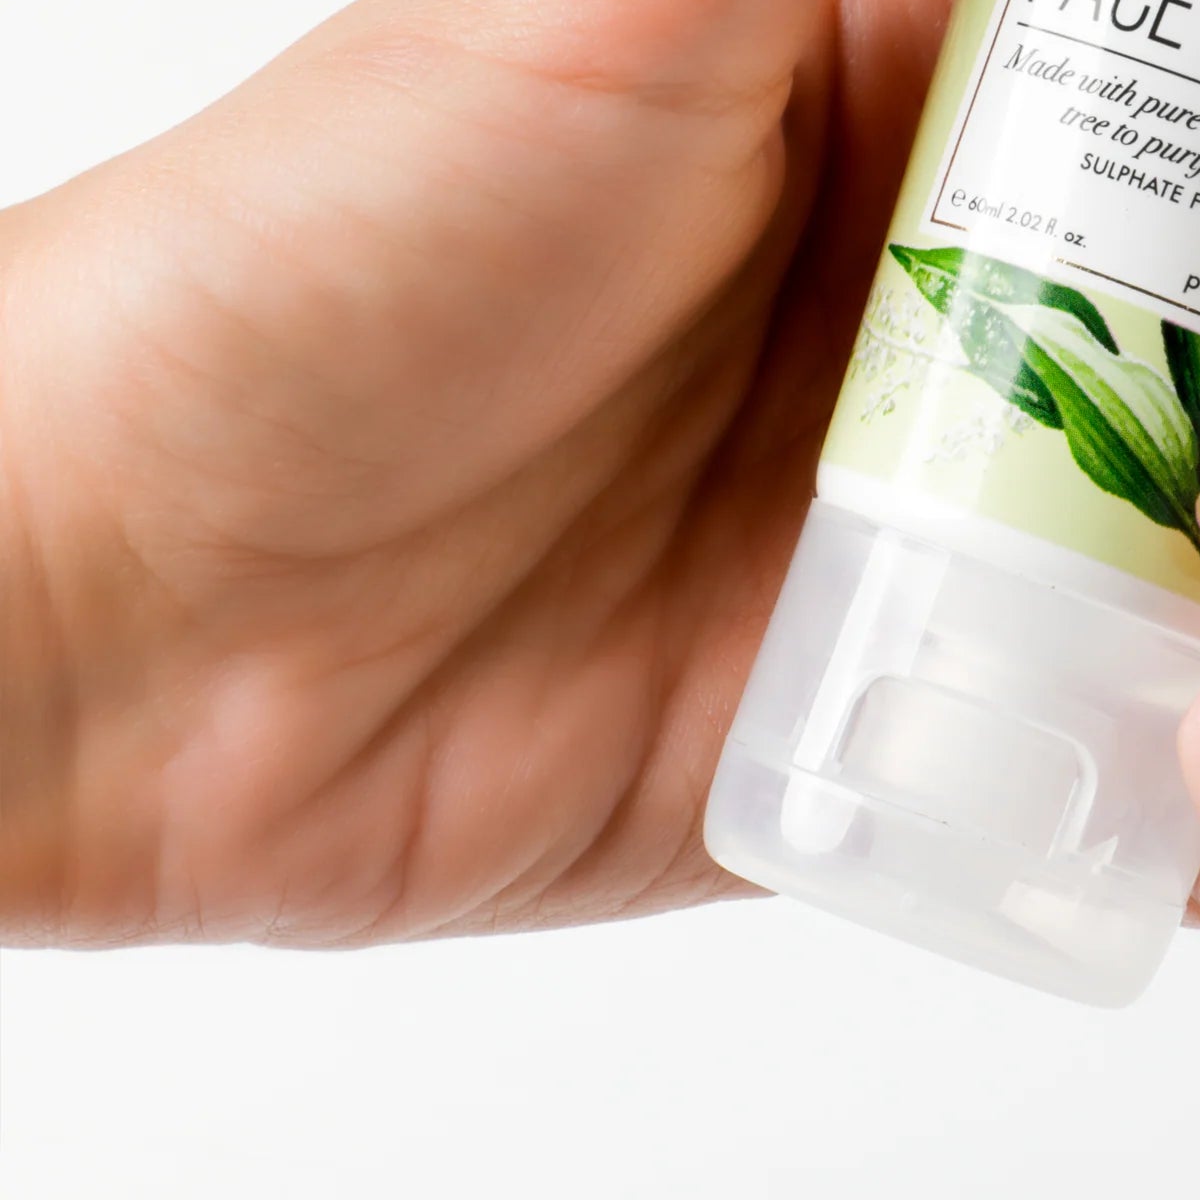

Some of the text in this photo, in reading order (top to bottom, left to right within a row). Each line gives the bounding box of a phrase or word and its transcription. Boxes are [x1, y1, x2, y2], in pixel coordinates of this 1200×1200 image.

[1002, 43, 1076, 86] Made
[1078, 73, 1137, 108] with
[1059, 104, 1105, 137] tree
[1110, 125, 1139, 146] to
[1080, 152, 1186, 204] SULPHATE
[968, 195, 1004, 219] 60ml
[1005, 207, 1042, 232] 2.02
[1044, 218, 1059, 237] fl.
[1064, 230, 1088, 248] oz.
